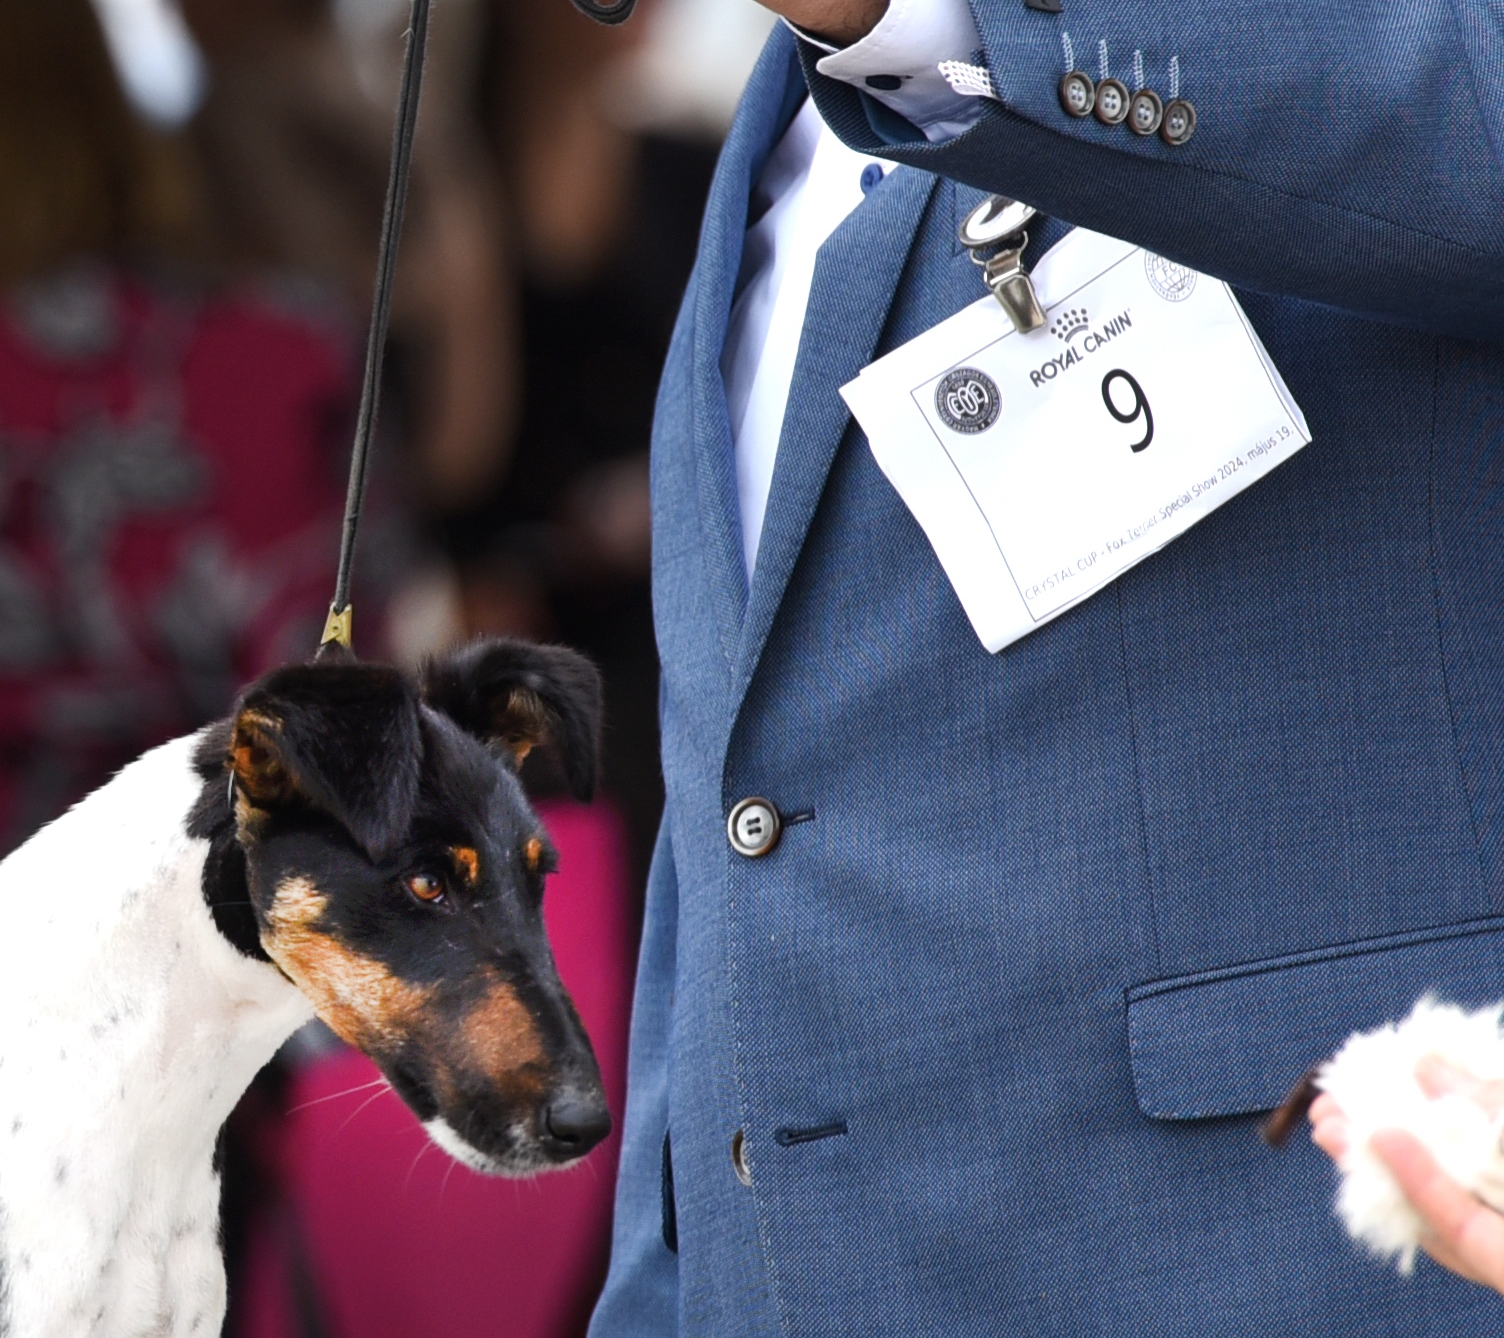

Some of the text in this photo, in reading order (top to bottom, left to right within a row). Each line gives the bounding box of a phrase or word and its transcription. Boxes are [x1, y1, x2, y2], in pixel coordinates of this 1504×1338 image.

[1029, 310, 1132, 388] ROYAL CANIN
[1101, 368, 1154, 453] 9
[1024, 567, 1077, 601] CRYSTAL
[1076, 551, 1098, 572] CUP
[1106, 537, 1127, 554] Fox
[1158, 490, 1193, 519] Special
[1191, 476, 1218, 499] Show
[1247, 437, 1277, 461] május
